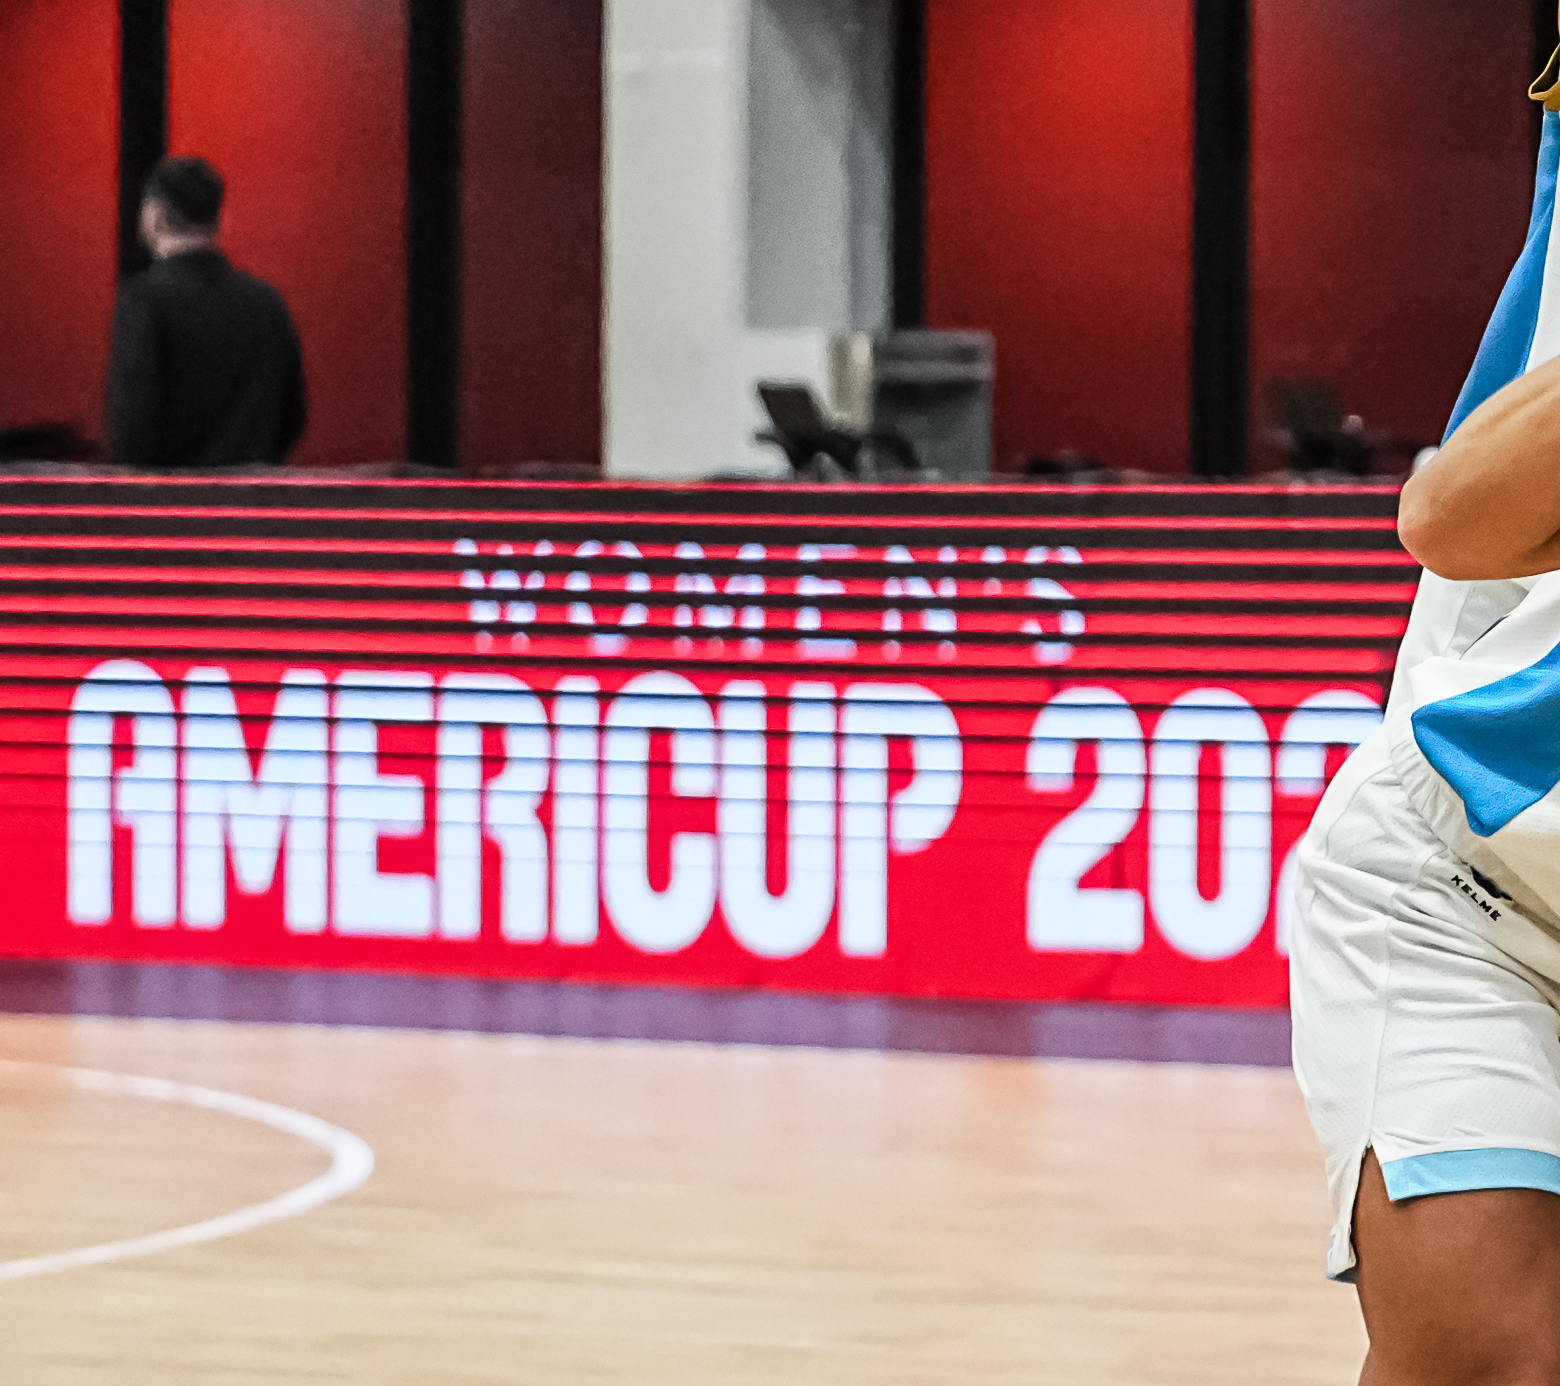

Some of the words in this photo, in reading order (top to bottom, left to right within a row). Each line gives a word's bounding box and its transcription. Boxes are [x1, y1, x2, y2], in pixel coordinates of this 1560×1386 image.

[453, 535, 1087, 666] WOMEN'S
[66, 658, 962, 960] AMERICUP
[1450, 874, 1502, 922] KELME
